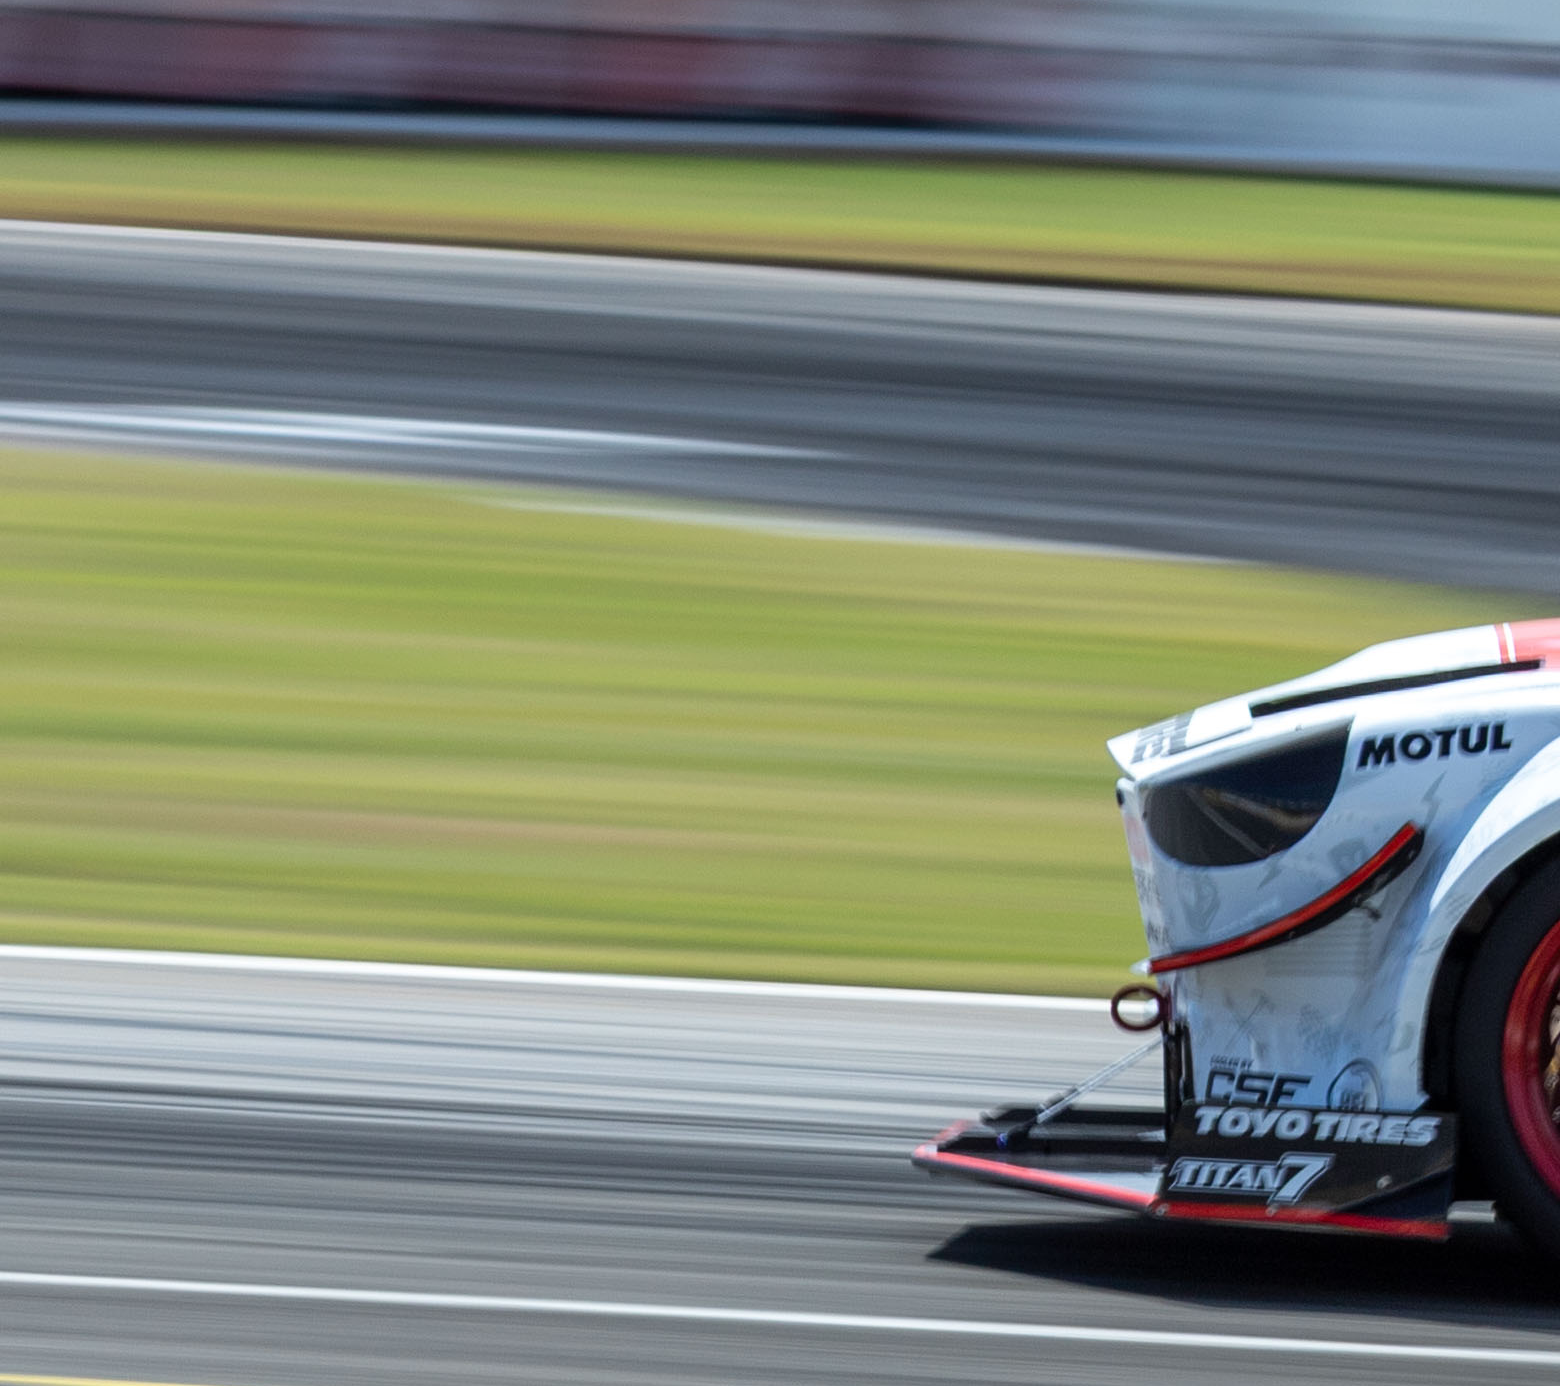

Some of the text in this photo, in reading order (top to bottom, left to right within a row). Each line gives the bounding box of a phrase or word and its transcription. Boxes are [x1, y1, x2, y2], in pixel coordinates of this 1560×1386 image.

[1356, 723, 1512, 770] MOTUL
[1206, 1067, 1313, 1106] CSF
[1194, 1105, 1442, 1147] TOYO TIRES
